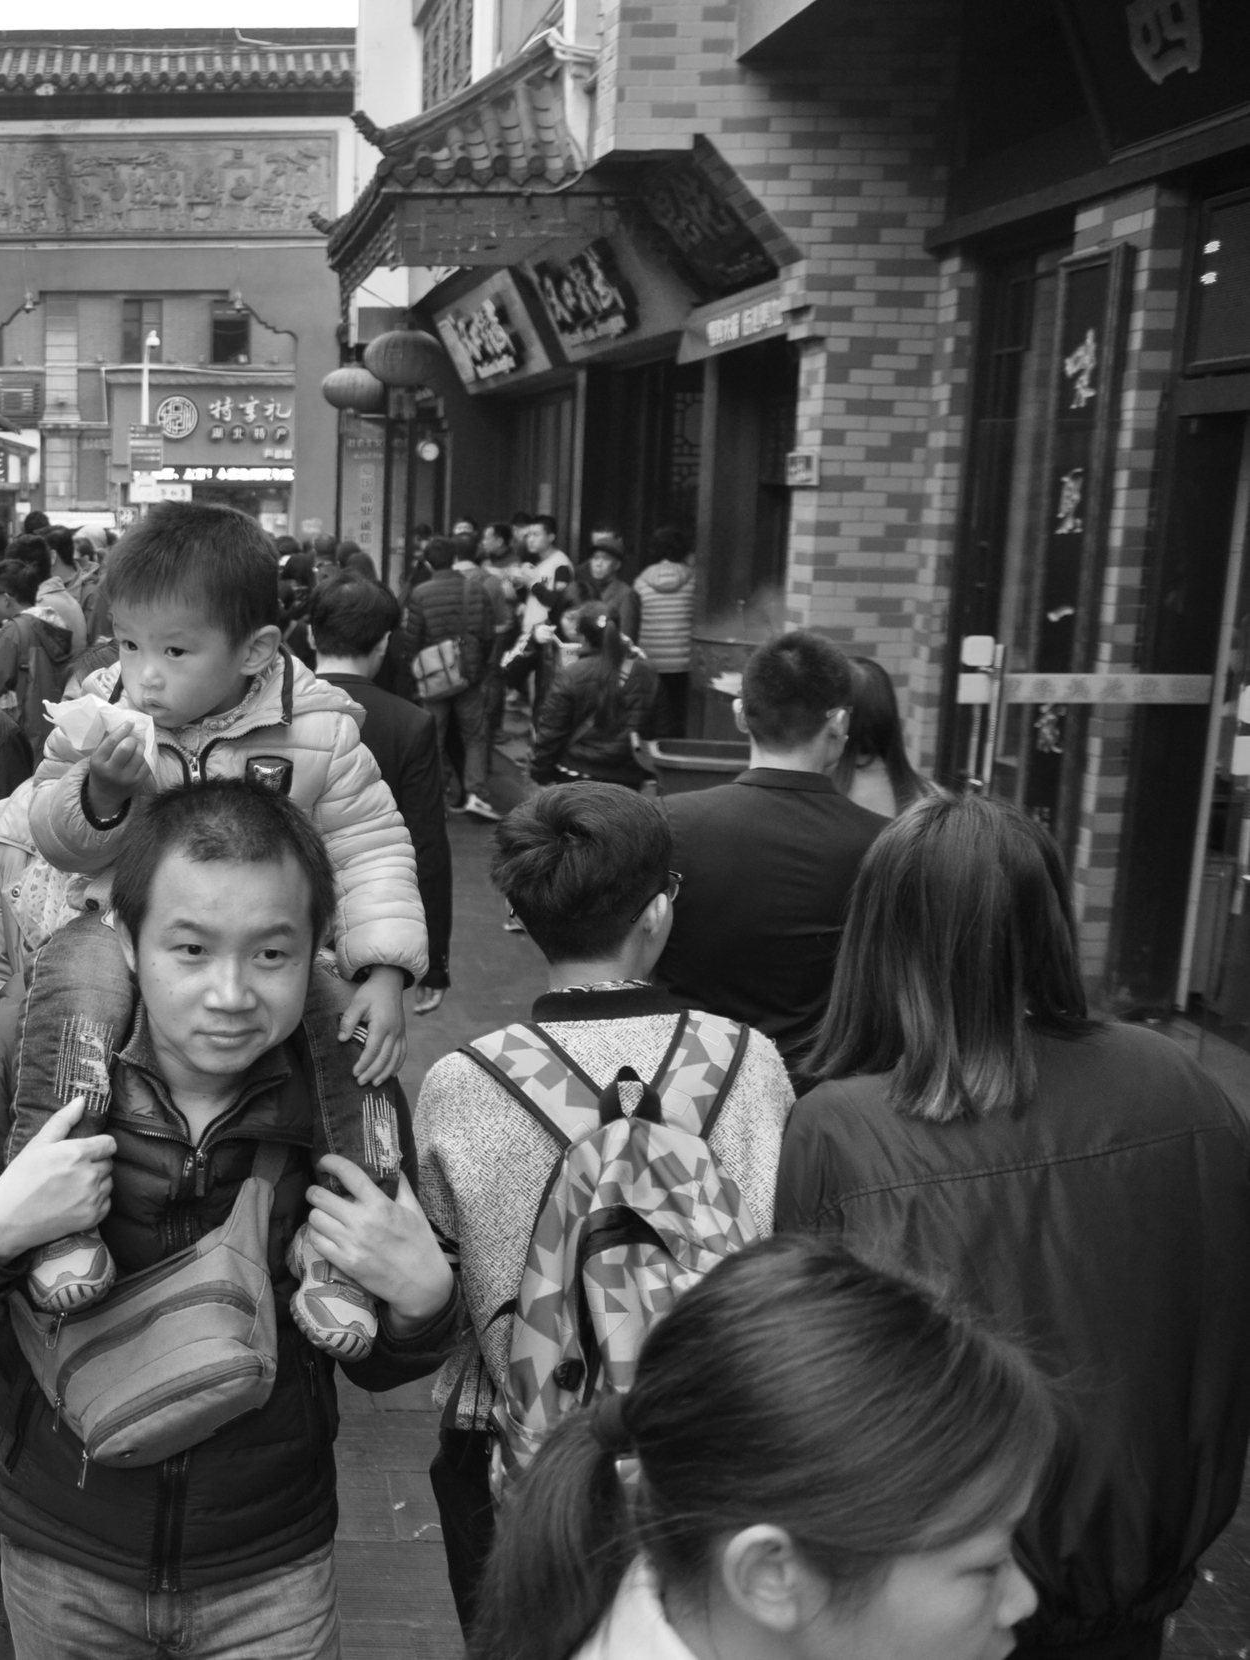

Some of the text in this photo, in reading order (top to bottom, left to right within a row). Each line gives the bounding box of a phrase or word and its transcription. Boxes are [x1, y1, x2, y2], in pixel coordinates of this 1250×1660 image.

[209, 395, 292, 422] 特享礼
[210, 425, 289, 443] 湖北特产
